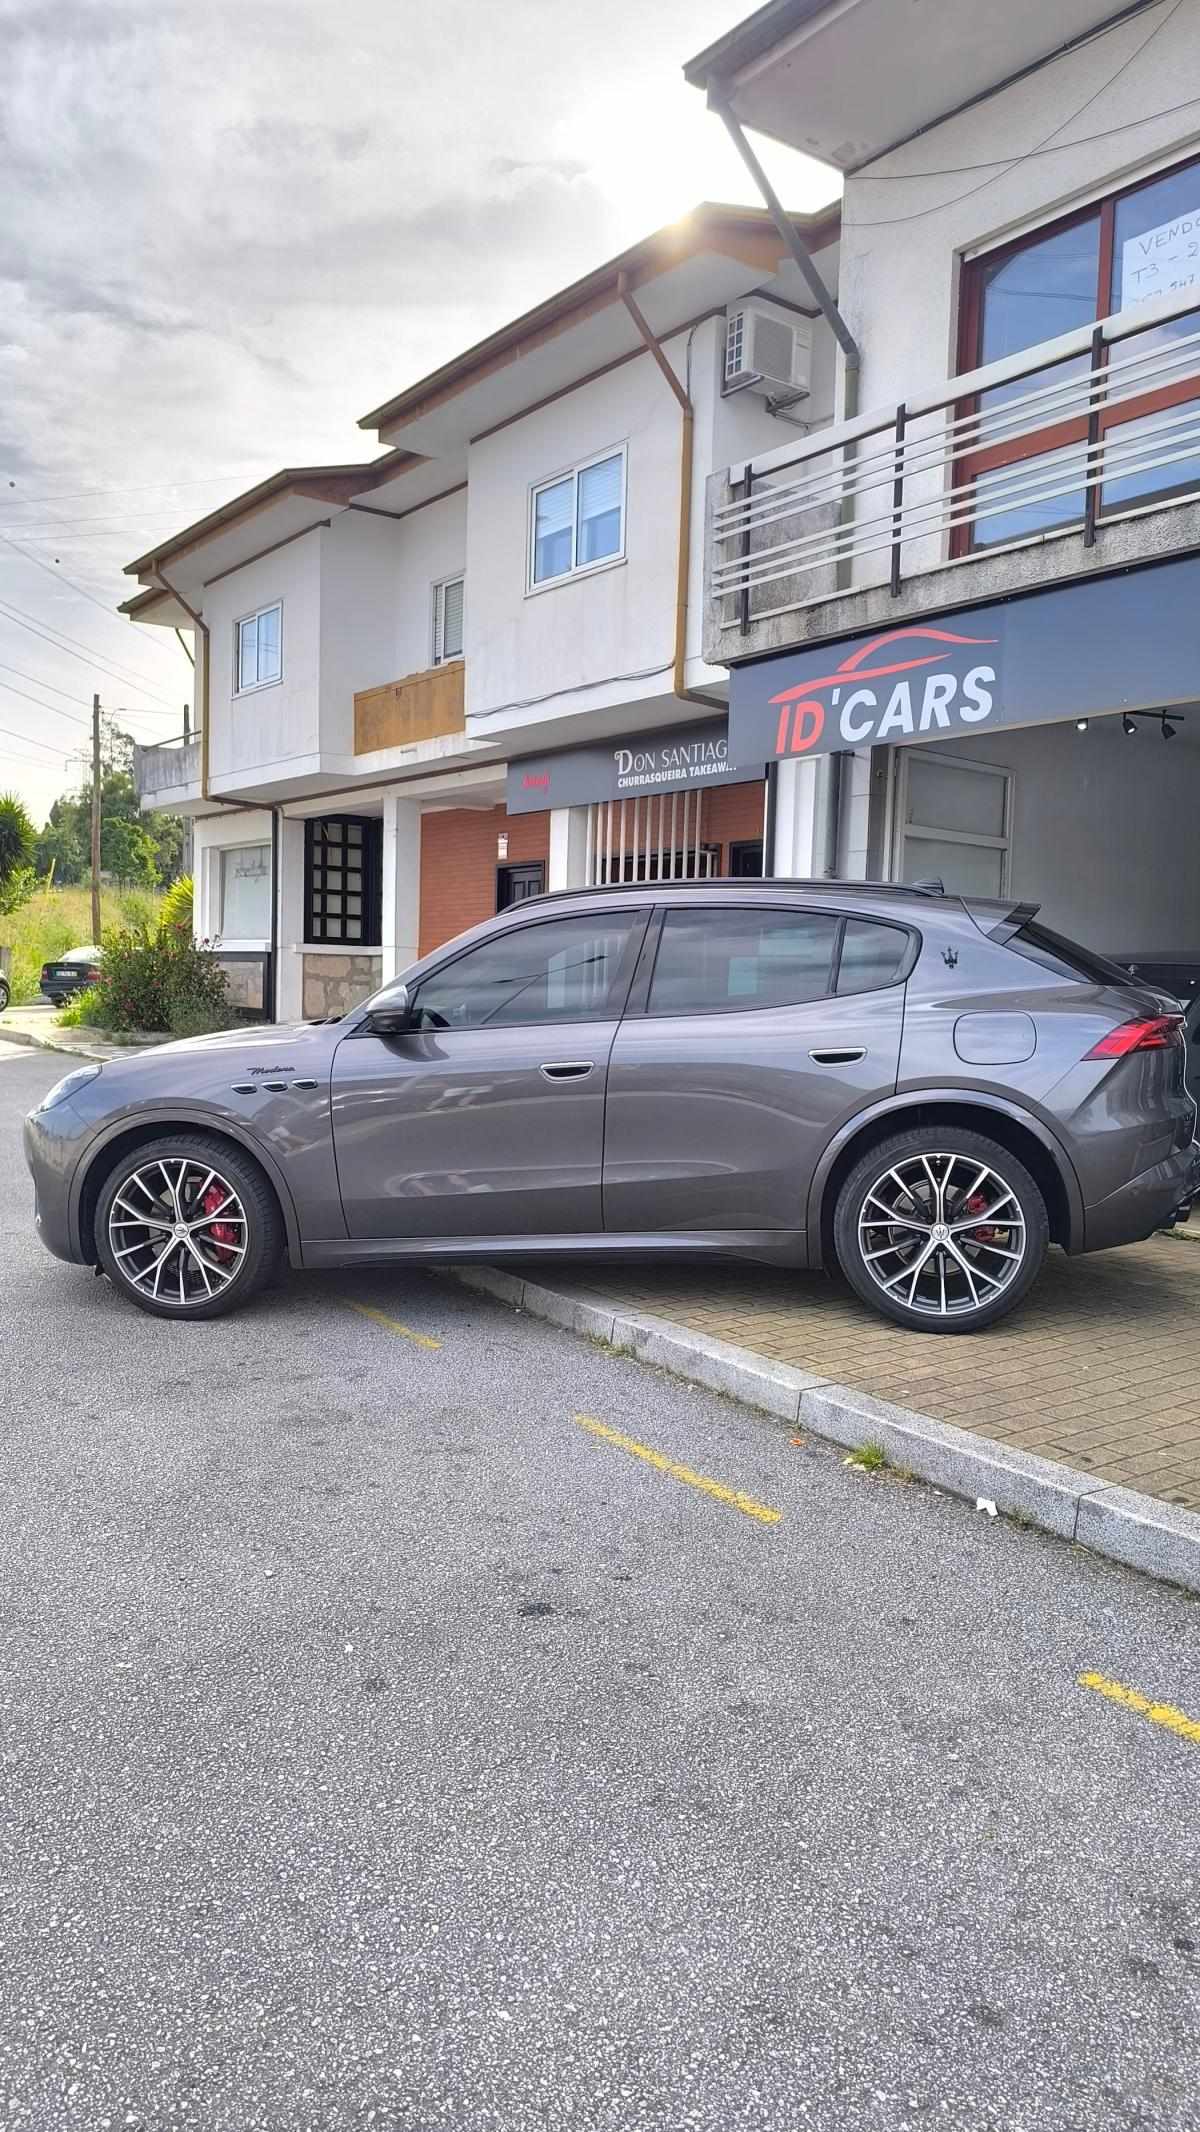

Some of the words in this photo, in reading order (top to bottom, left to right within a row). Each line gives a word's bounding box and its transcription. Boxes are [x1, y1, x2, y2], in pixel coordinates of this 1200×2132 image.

[776, 666, 996, 754] ID'CARS
[661, 739, 728, 768] SANTIAG
[617, 767, 688, 788] CHURRASQUEIRA
[689, 761, 737, 777] TAKEAW
